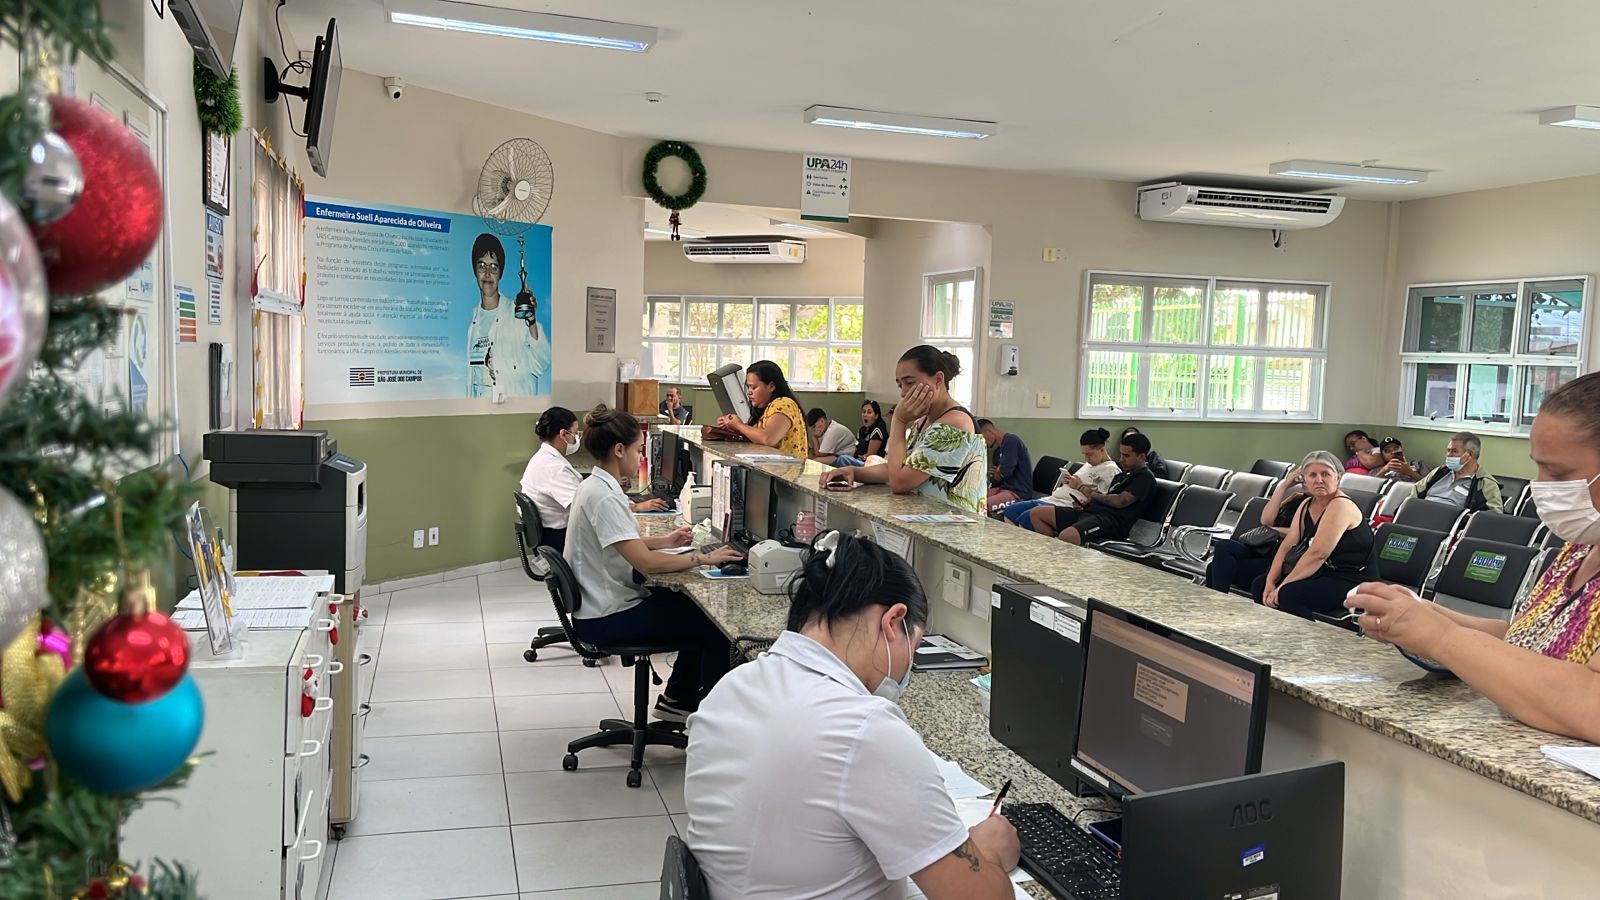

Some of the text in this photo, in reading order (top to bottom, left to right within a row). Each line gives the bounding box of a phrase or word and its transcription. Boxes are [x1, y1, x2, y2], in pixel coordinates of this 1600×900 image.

[316, 207, 442, 230] Enfermeira Sueli Aparecida de Oliveira
[1231, 799, 1274, 828] AOC
